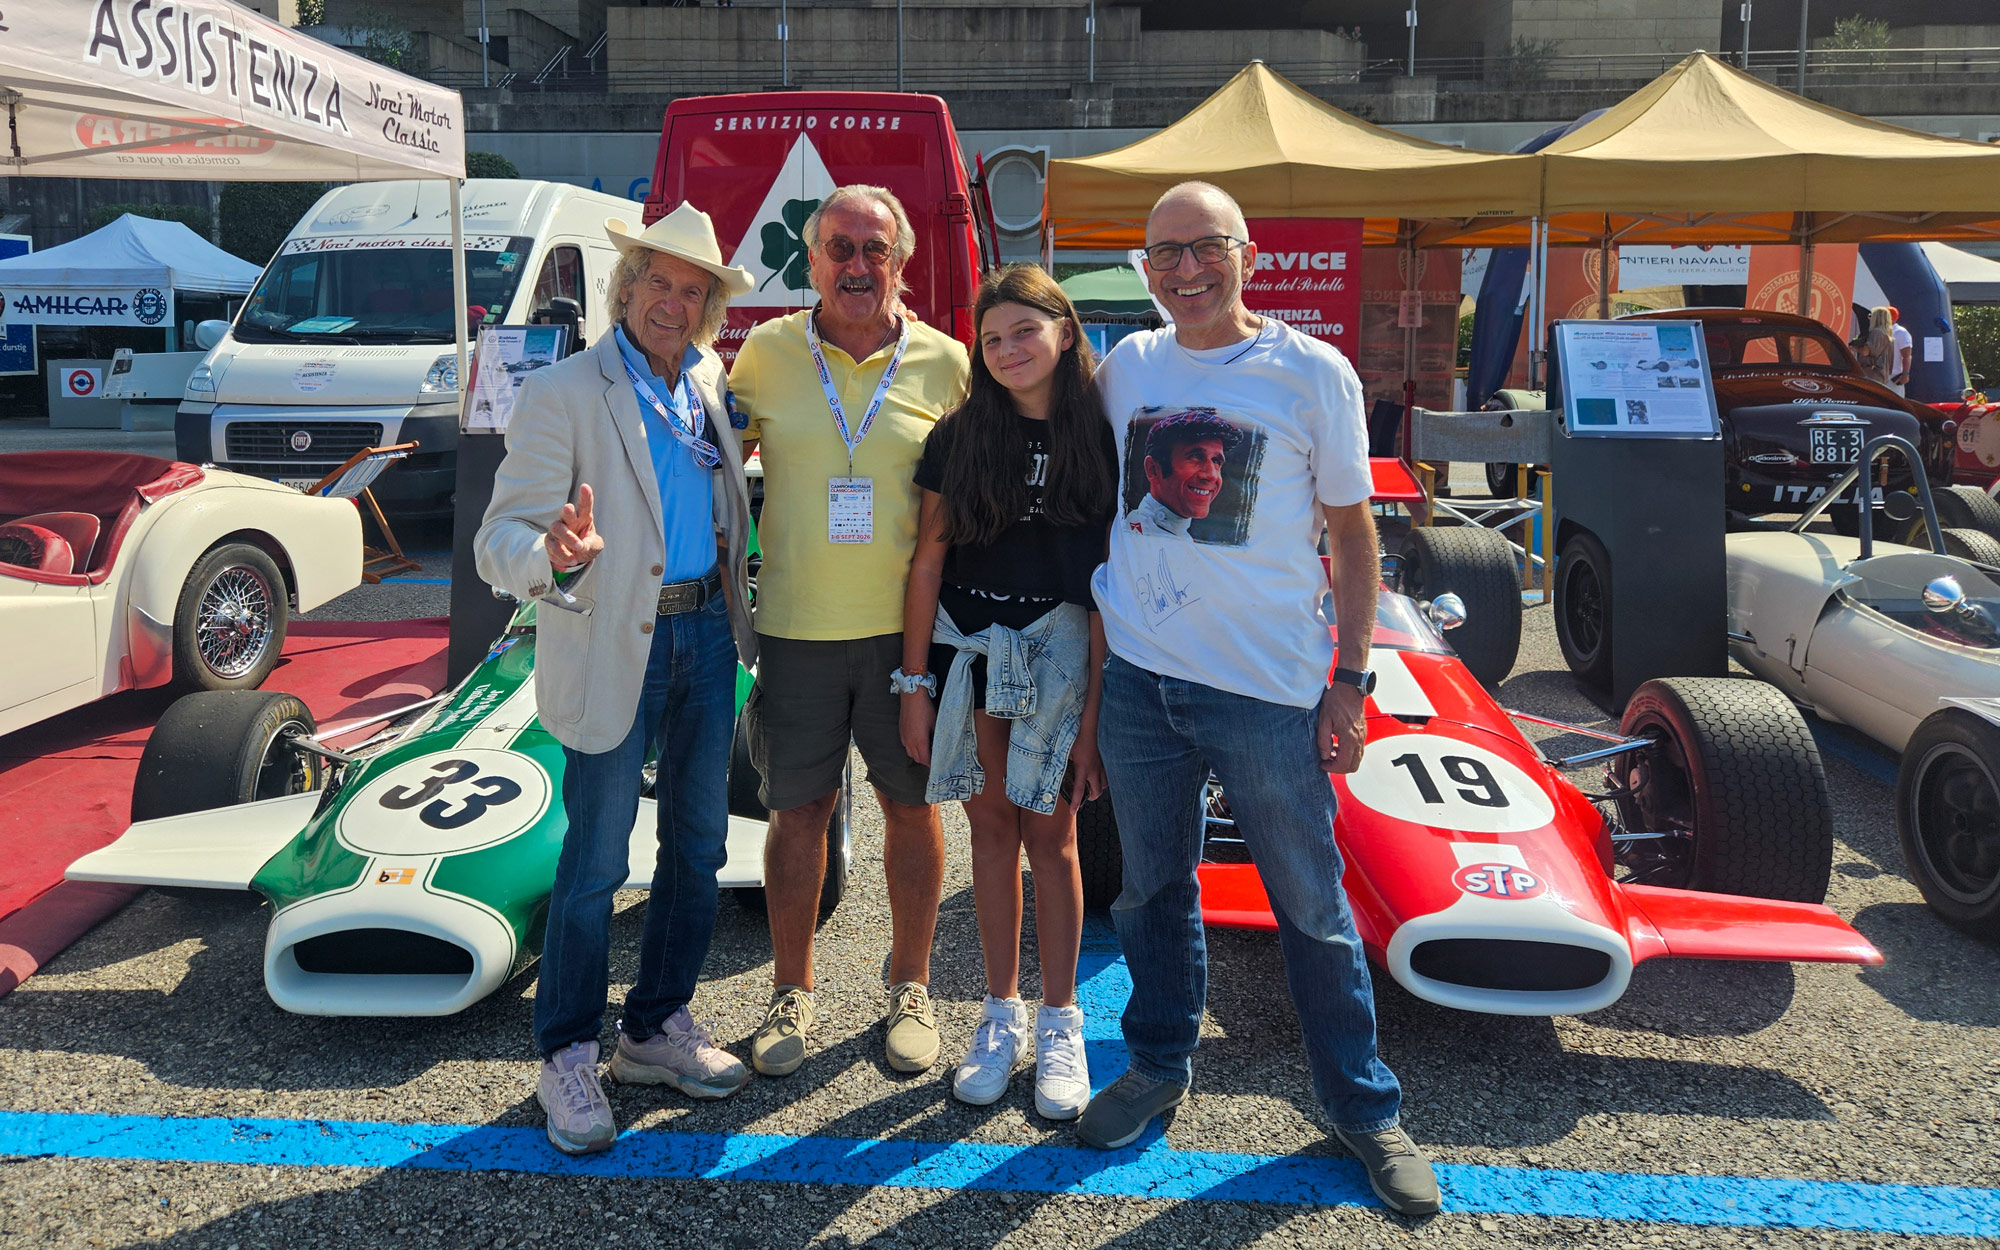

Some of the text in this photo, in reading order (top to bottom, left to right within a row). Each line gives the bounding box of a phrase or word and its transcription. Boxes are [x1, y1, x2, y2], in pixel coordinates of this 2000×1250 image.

[89, 0, 348, 132] ASSISTENZA
[365, 81, 452, 130] Noci Motor
[714, 115, 901, 131] SERVIZIO CORSE
[382, 116, 441, 153] Classic
[311, 237, 354, 250] Noci
[356, 239, 406, 249] motor
[1679, 256, 1733, 265] NAVALI
[1275, 277, 1298, 291] del
[1297, 277, 1345, 292] Portello
[13, 295, 128, 317] AMILCAR
[2, 343, 27, 353] durstig
[1792, 397, 1858, 406] Alfa Romeo
[295, 433, 308, 447] FIAT
[1962, 429, 1976, 443] 61
[1814, 447, 1861, 462] 8812
[1390, 752, 1511, 808] 19
[378, 758, 522, 830] 33
[1464, 865, 1538, 896] STP
